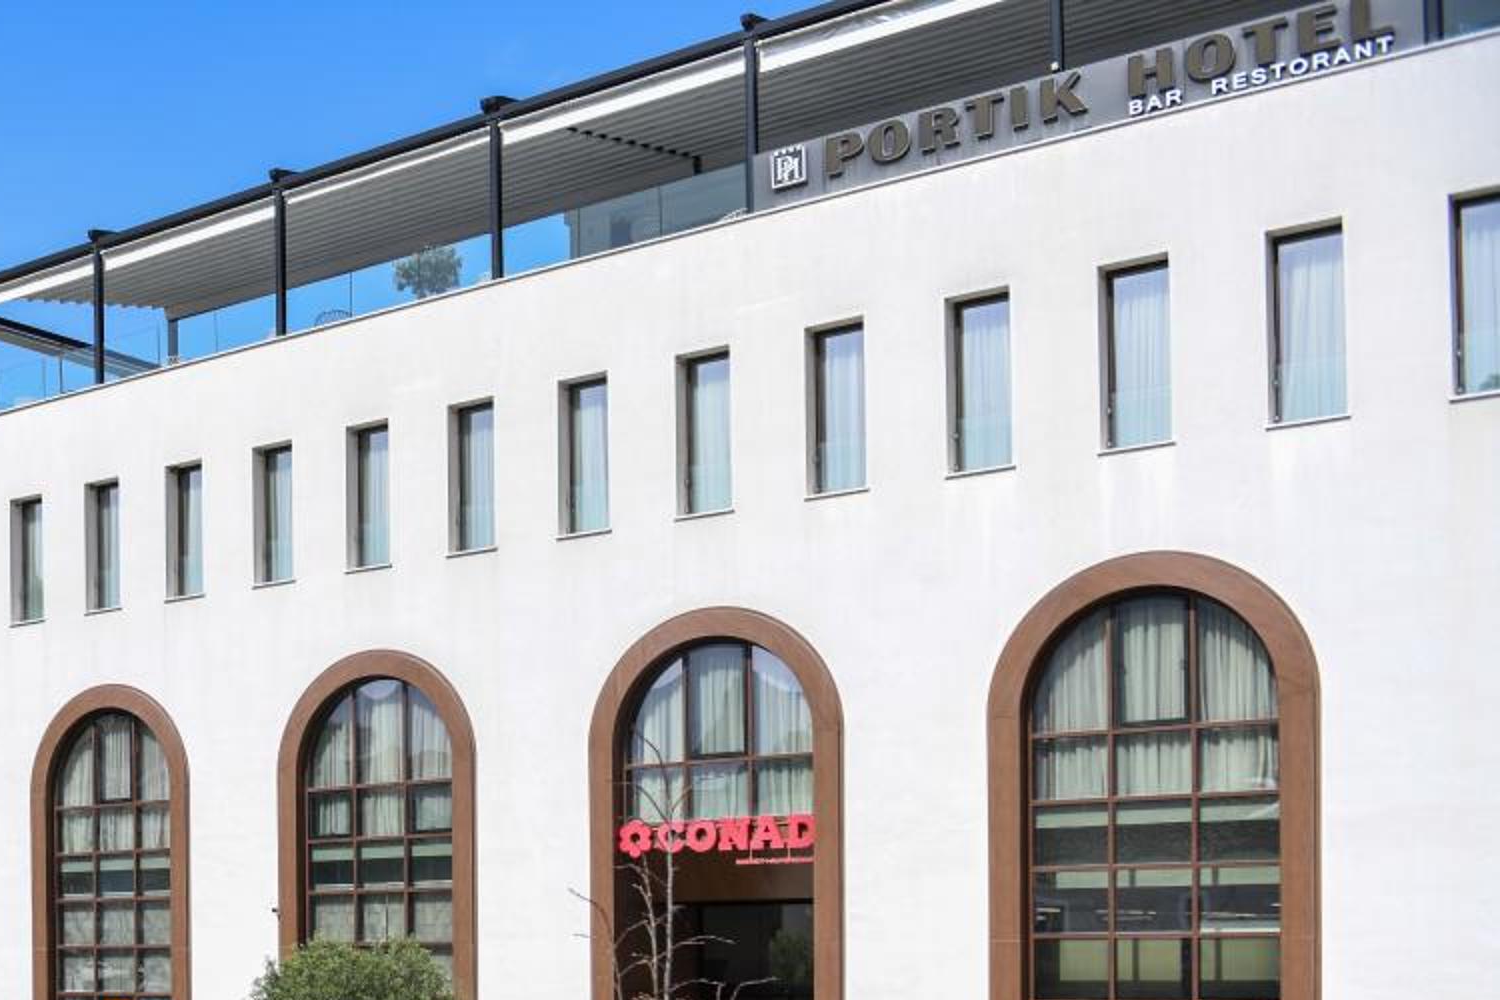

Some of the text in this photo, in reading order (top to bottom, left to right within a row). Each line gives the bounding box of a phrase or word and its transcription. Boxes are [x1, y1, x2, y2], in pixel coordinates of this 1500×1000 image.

[824, 0, 1395, 178] PORTIK HOTEL
[1128, 36, 1395, 116] BAR RESTORANT
[657, 813, 817, 853] CONAD
